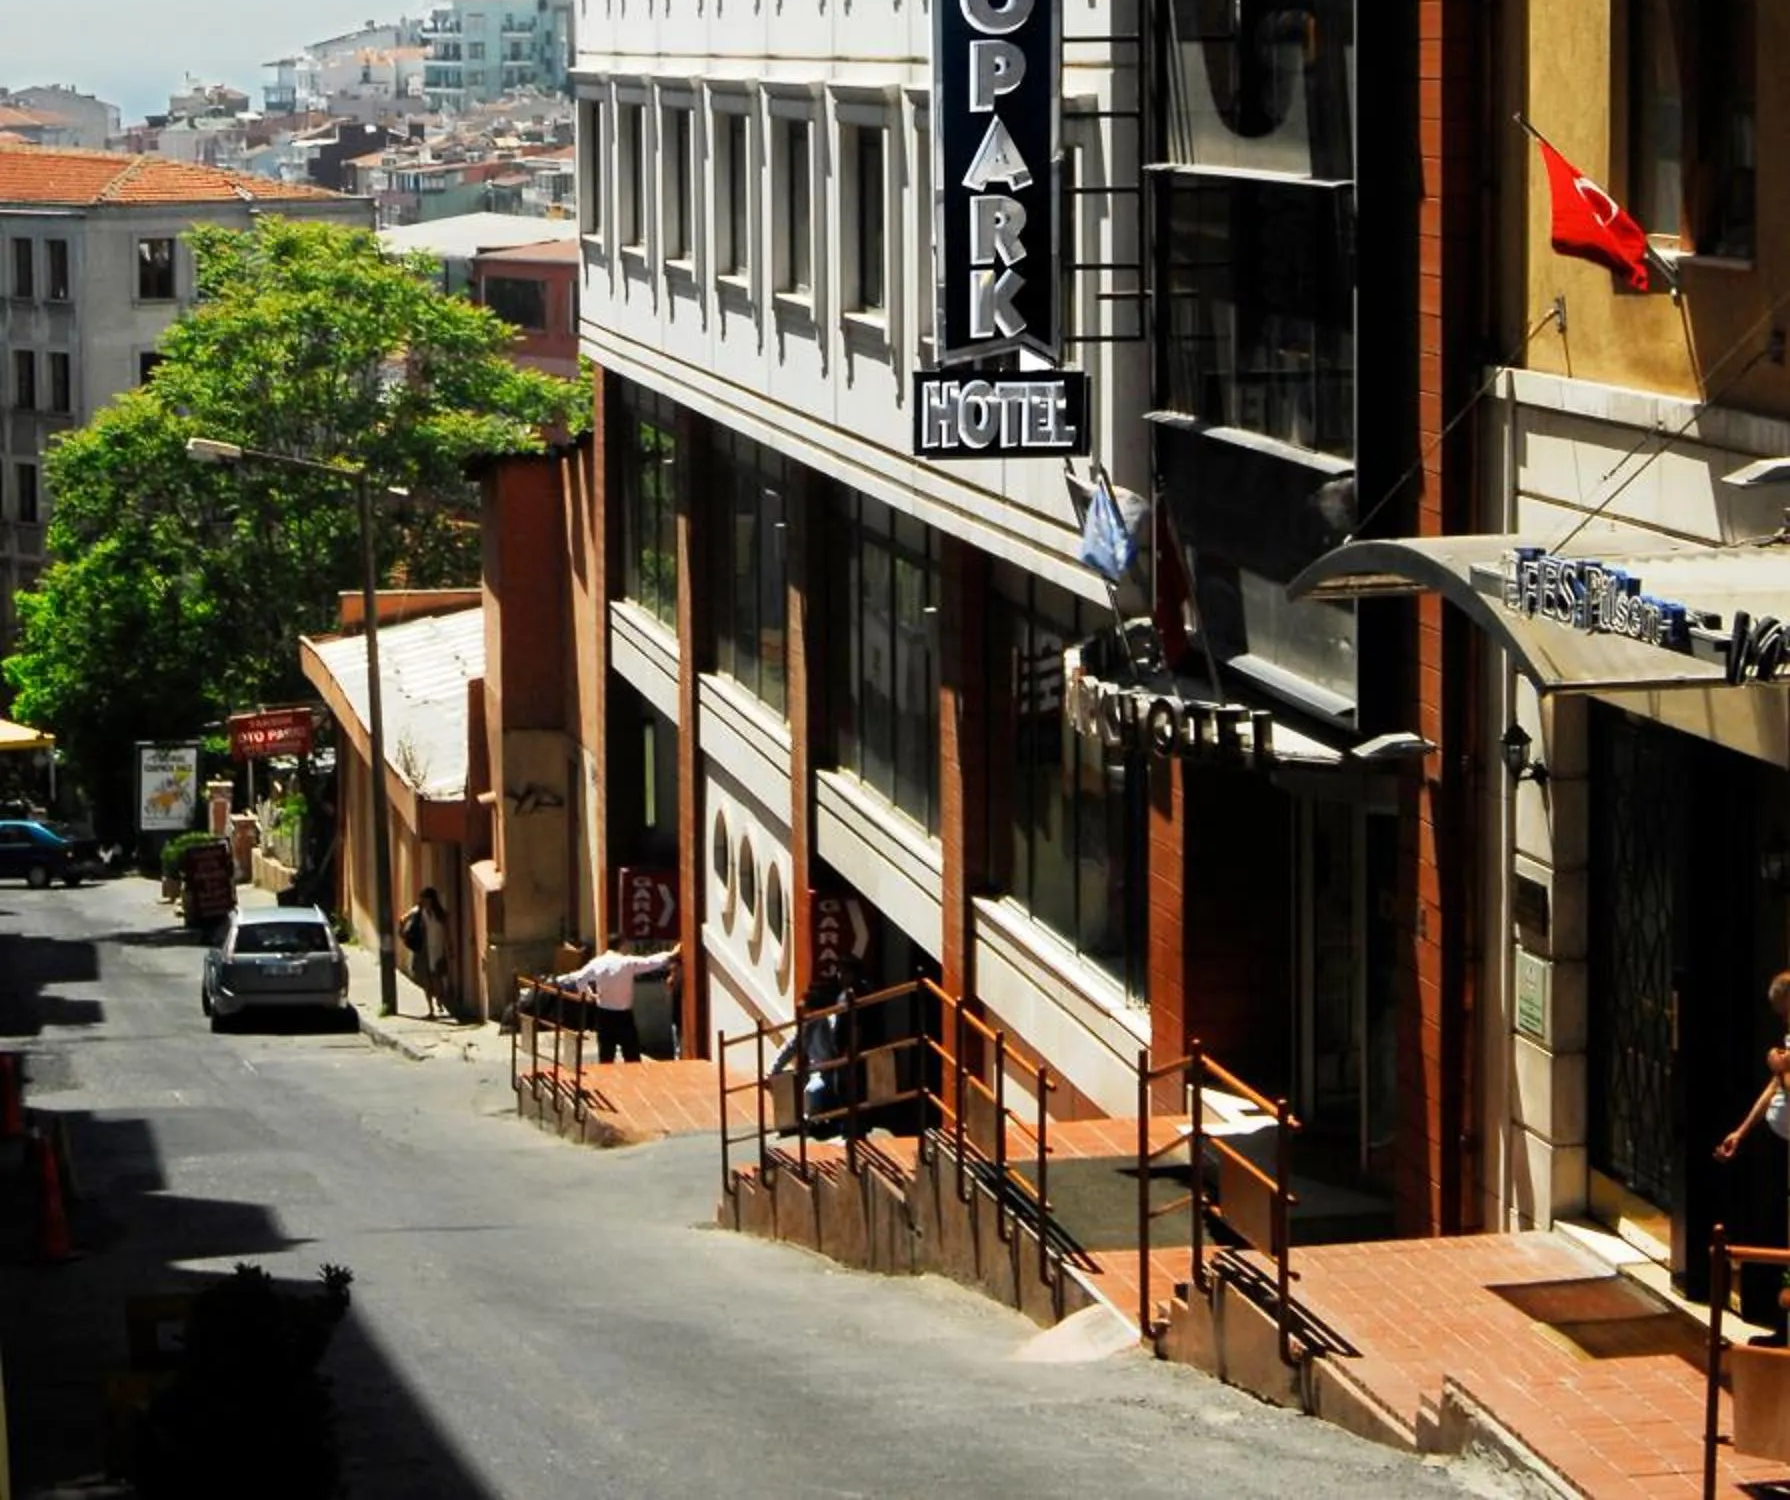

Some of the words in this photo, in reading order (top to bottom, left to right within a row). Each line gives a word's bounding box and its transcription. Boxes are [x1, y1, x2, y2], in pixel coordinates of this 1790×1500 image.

[921, 379, 1077, 449] HOTEL
[632, 875, 653, 936] GARAJ
[818, 899, 841, 978] GARAJ
